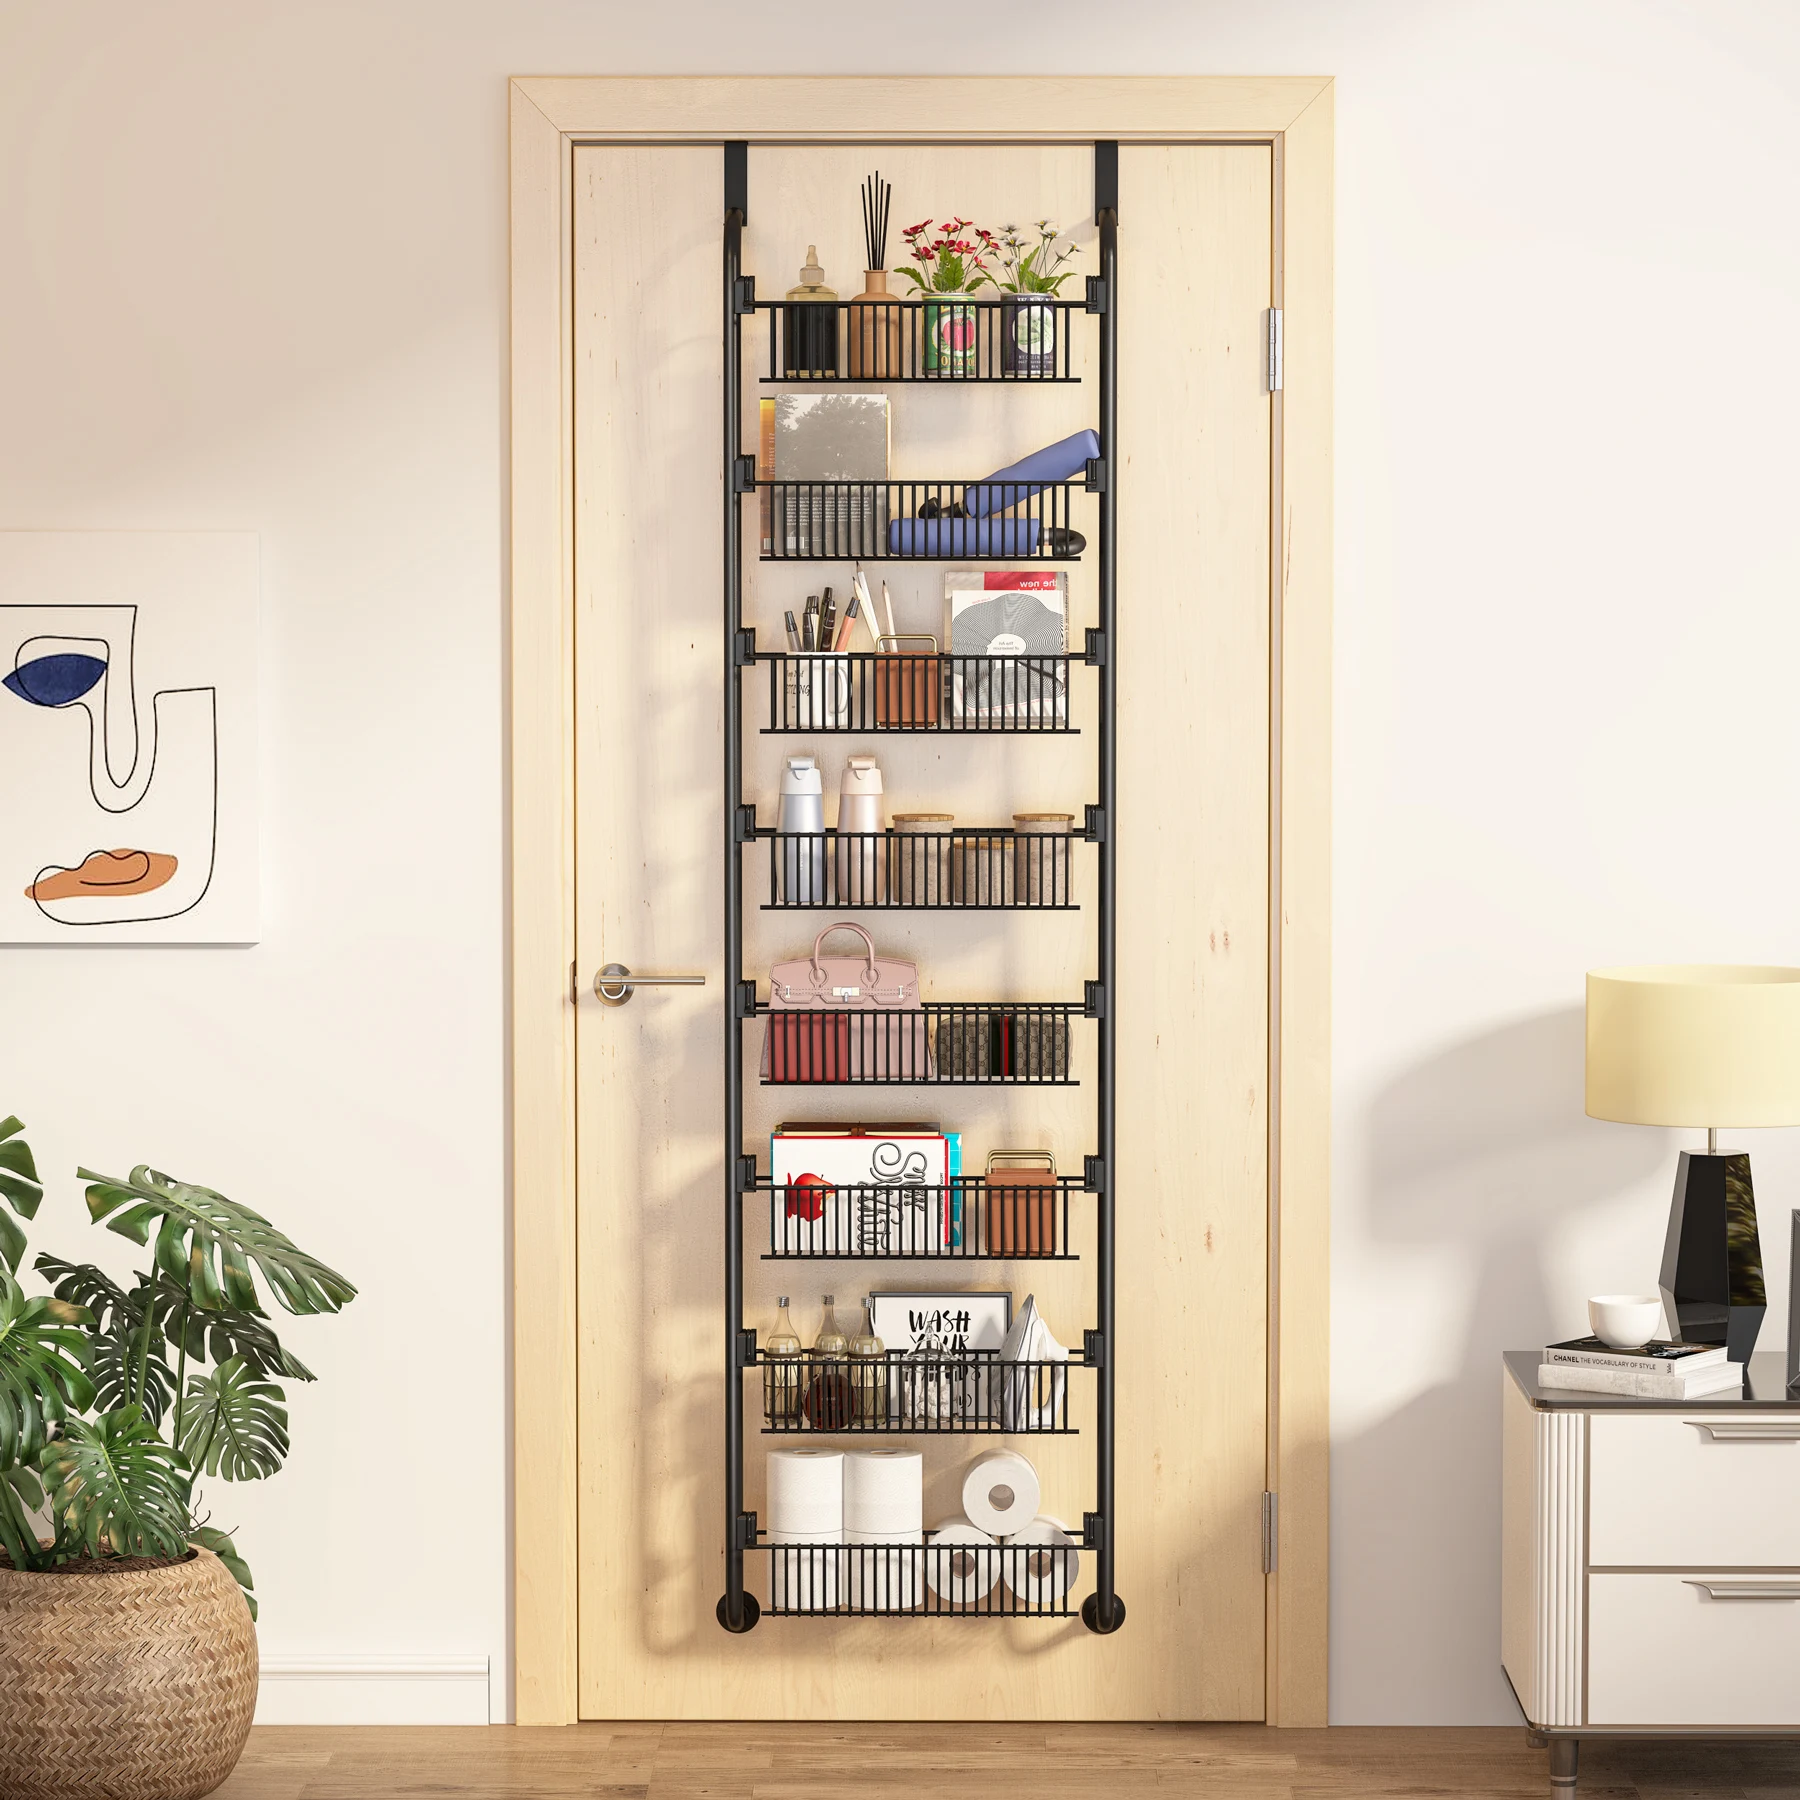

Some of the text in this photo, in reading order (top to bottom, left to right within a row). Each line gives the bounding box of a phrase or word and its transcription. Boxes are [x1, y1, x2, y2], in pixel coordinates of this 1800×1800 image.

[909, 1310, 971, 1333] WASH
[1553, 1355, 1580, 1363] CHANEL
[1592, 1358, 1630, 1368] VOCABULARY
